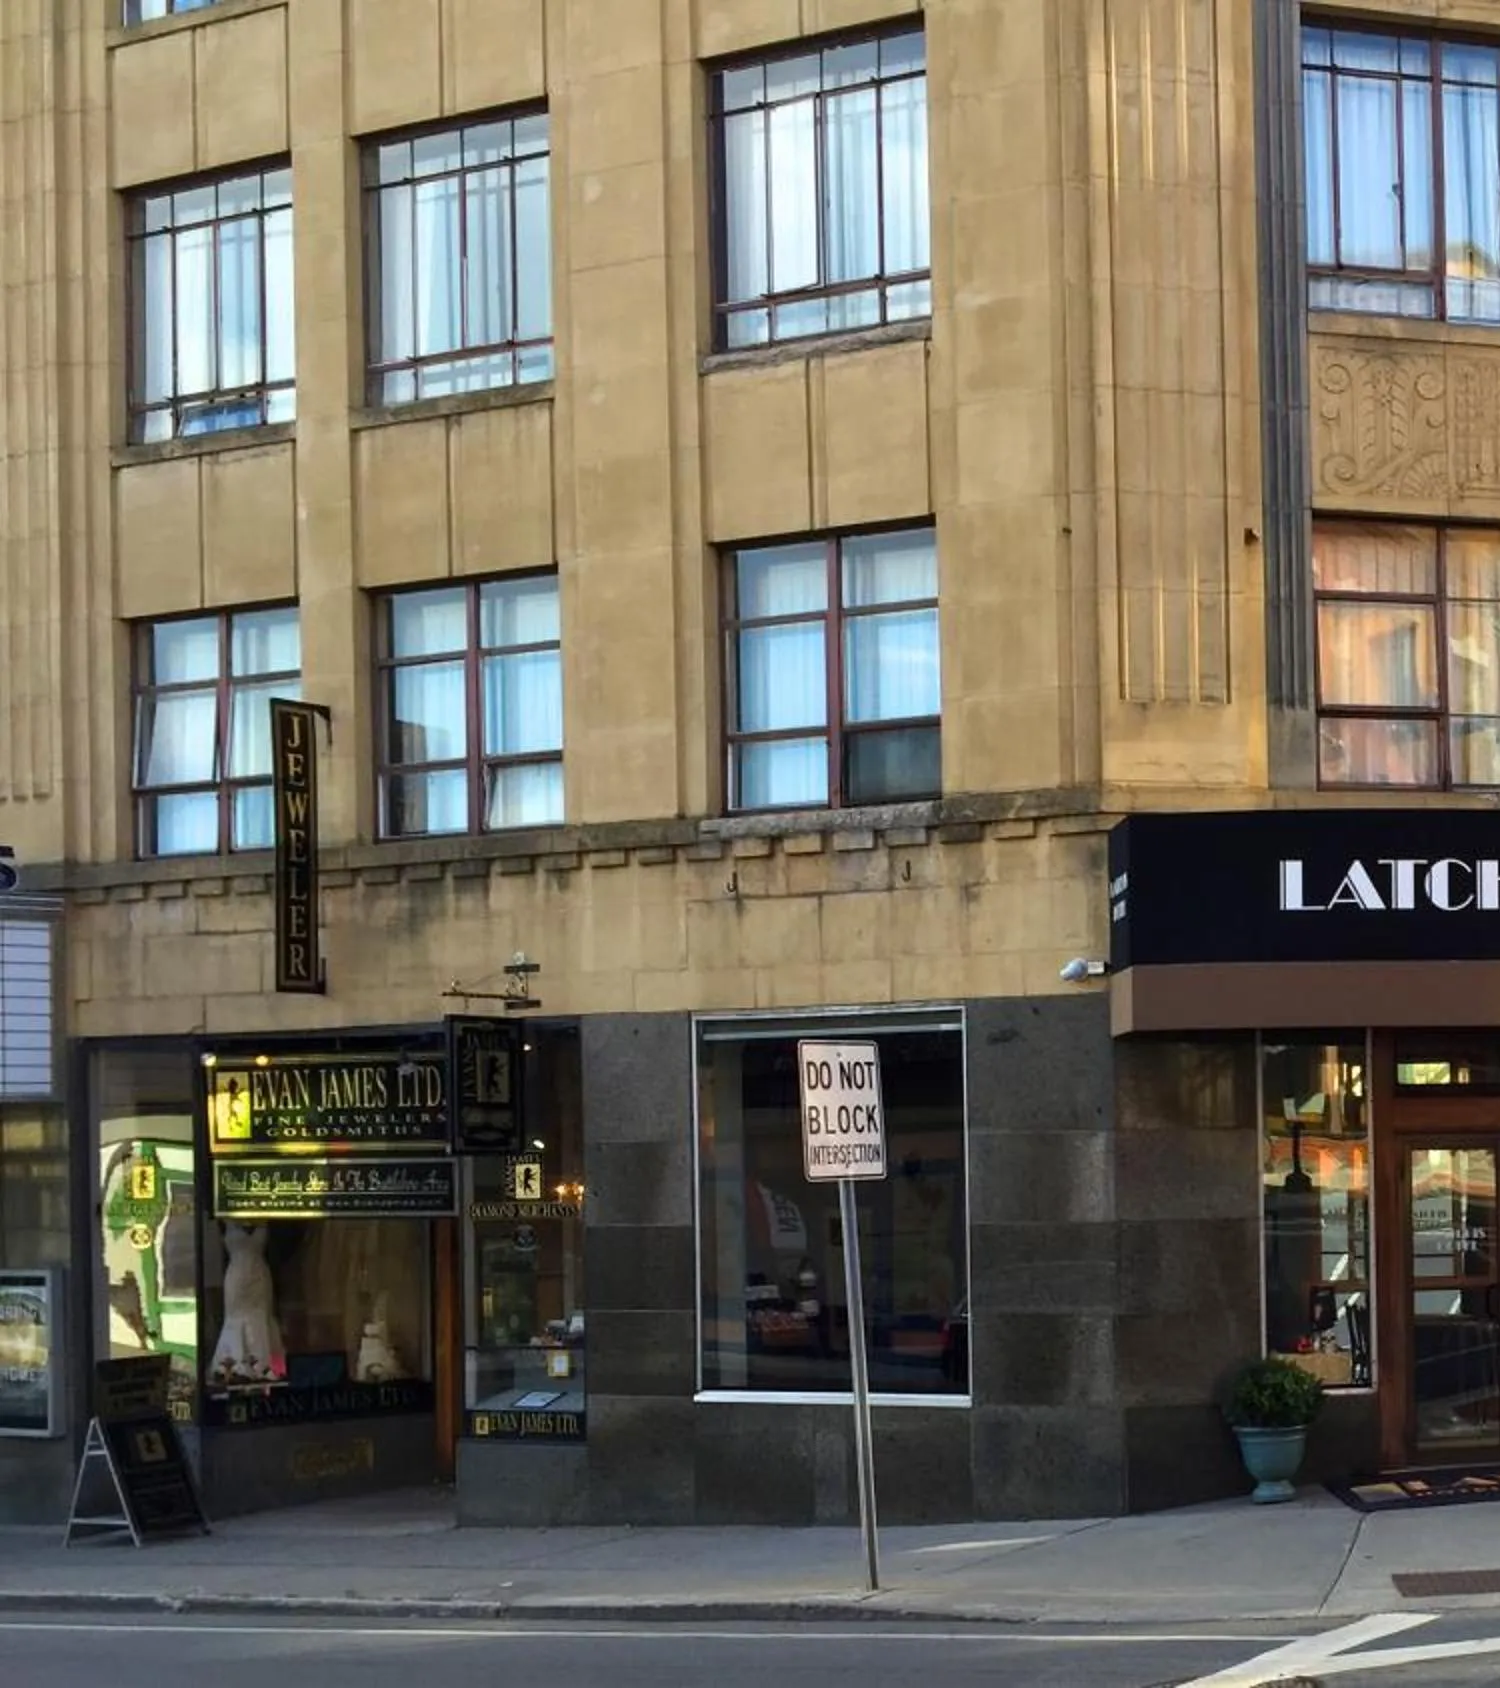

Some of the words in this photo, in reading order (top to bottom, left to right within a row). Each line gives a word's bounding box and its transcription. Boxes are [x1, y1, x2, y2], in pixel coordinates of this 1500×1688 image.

[286, 715, 308, 977] JEWELER
[252, 1069, 310, 1111] EVAN
[317, 1066, 387, 1113] JAMES
[806, 1061, 832, 1090] DO
[839, 1061, 874, 1090] NOT
[253, 1115, 305, 1126] FINE
[327, 1112, 448, 1125] JEWELERS
[266, 1125, 422, 1137] GOLDSMITHS
[807, 1105, 879, 1135] BLOCK
[810, 1143, 881, 1166] INTERSECTION
[519, 1410, 554, 1437] JAMES
